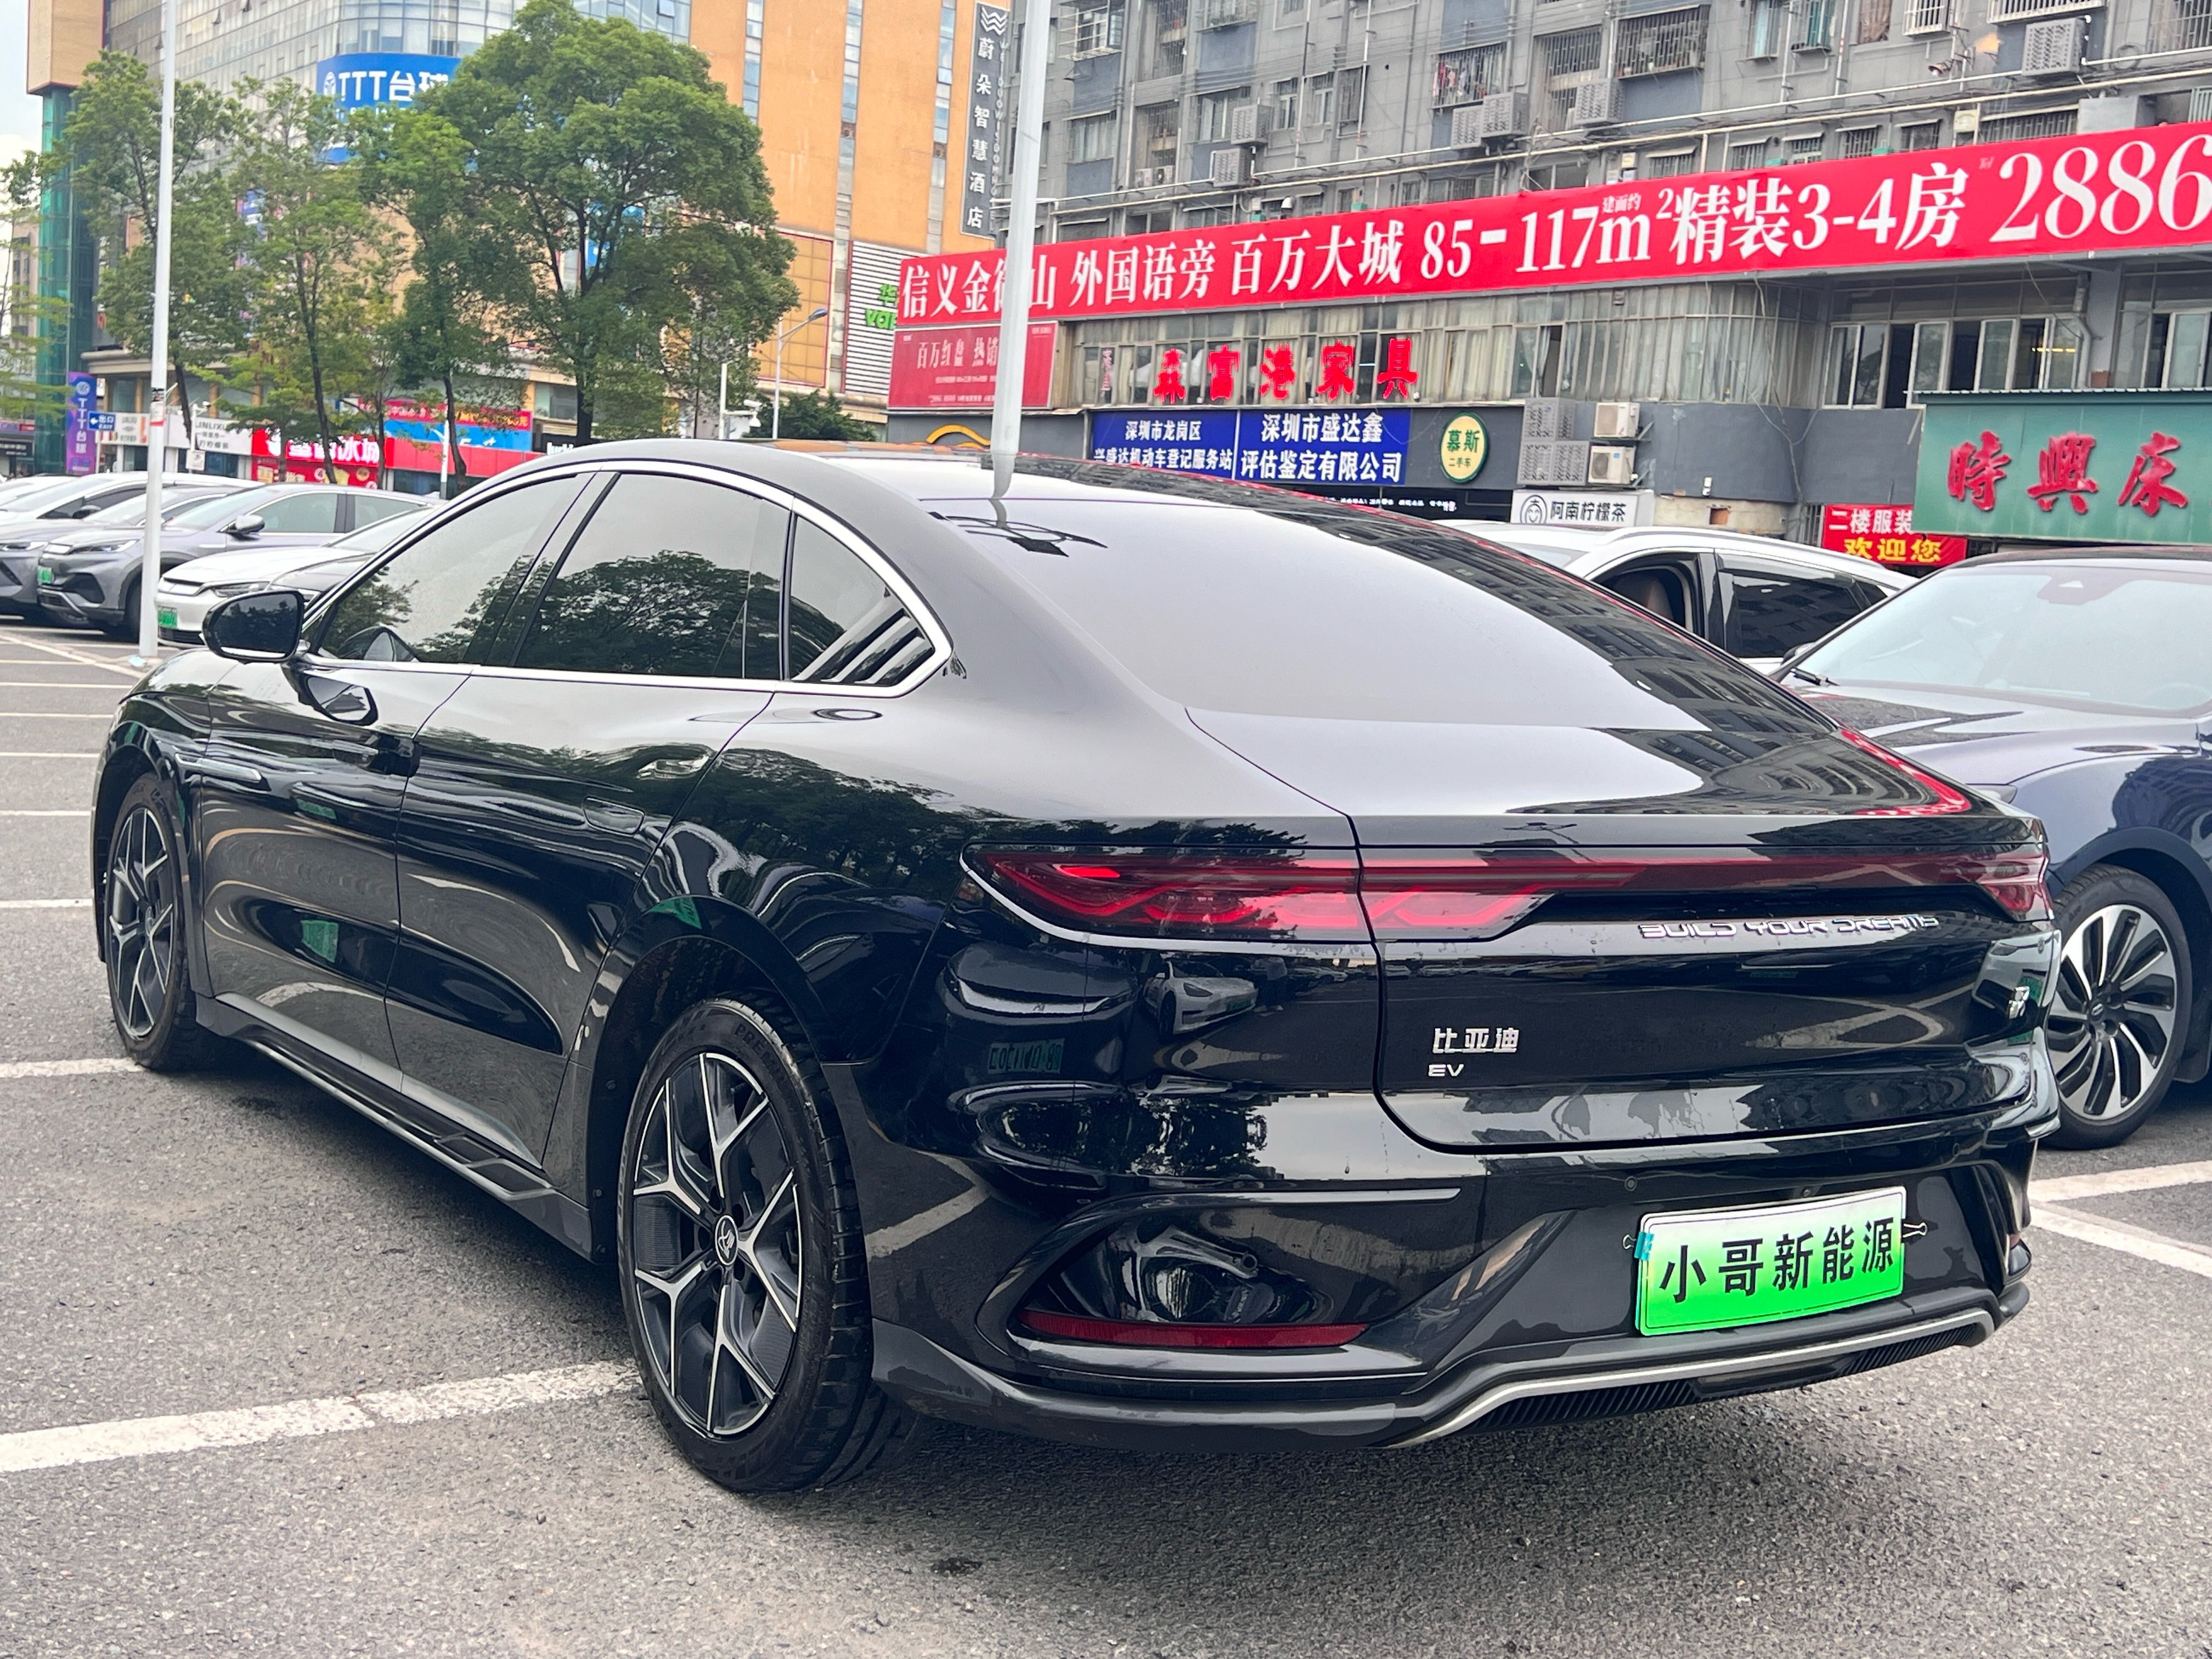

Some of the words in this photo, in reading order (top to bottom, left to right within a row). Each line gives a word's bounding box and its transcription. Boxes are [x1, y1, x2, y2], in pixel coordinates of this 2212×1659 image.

[967, 38, 994, 229] 蔚朵智慧酒店
[1989, 134, 2212, 242] 2886
[1602, 193, 1641, 214] 建面约
[1070, 239, 1216, 307] 外国语旁
[1231, 219, 1406, 296] 百万大城
[1125, 420, 1202, 441] 深圳市龙岗区
[1261, 412, 1384, 443] 深圳市盛达鑫
[1447, 429, 1480, 453] 慕斯
[1240, 449, 1402, 483] 评估鉴定有限公司
[1448, 457, 1472, 468] 二手车
[1829, 509, 1914, 535] 二楼服装
[1844, 537, 1941, 562] 欢迎您
[1639, 922, 1737, 939] BUILD
[1745, 920, 1829, 935] YOUR
[1832, 913, 1939, 933] DREAMS
[1432, 1028, 1520, 1054] 比亚迪
[1428, 1064, 1465, 1077] EV
[1659, 1217, 1894, 1304] 小哥新能源
